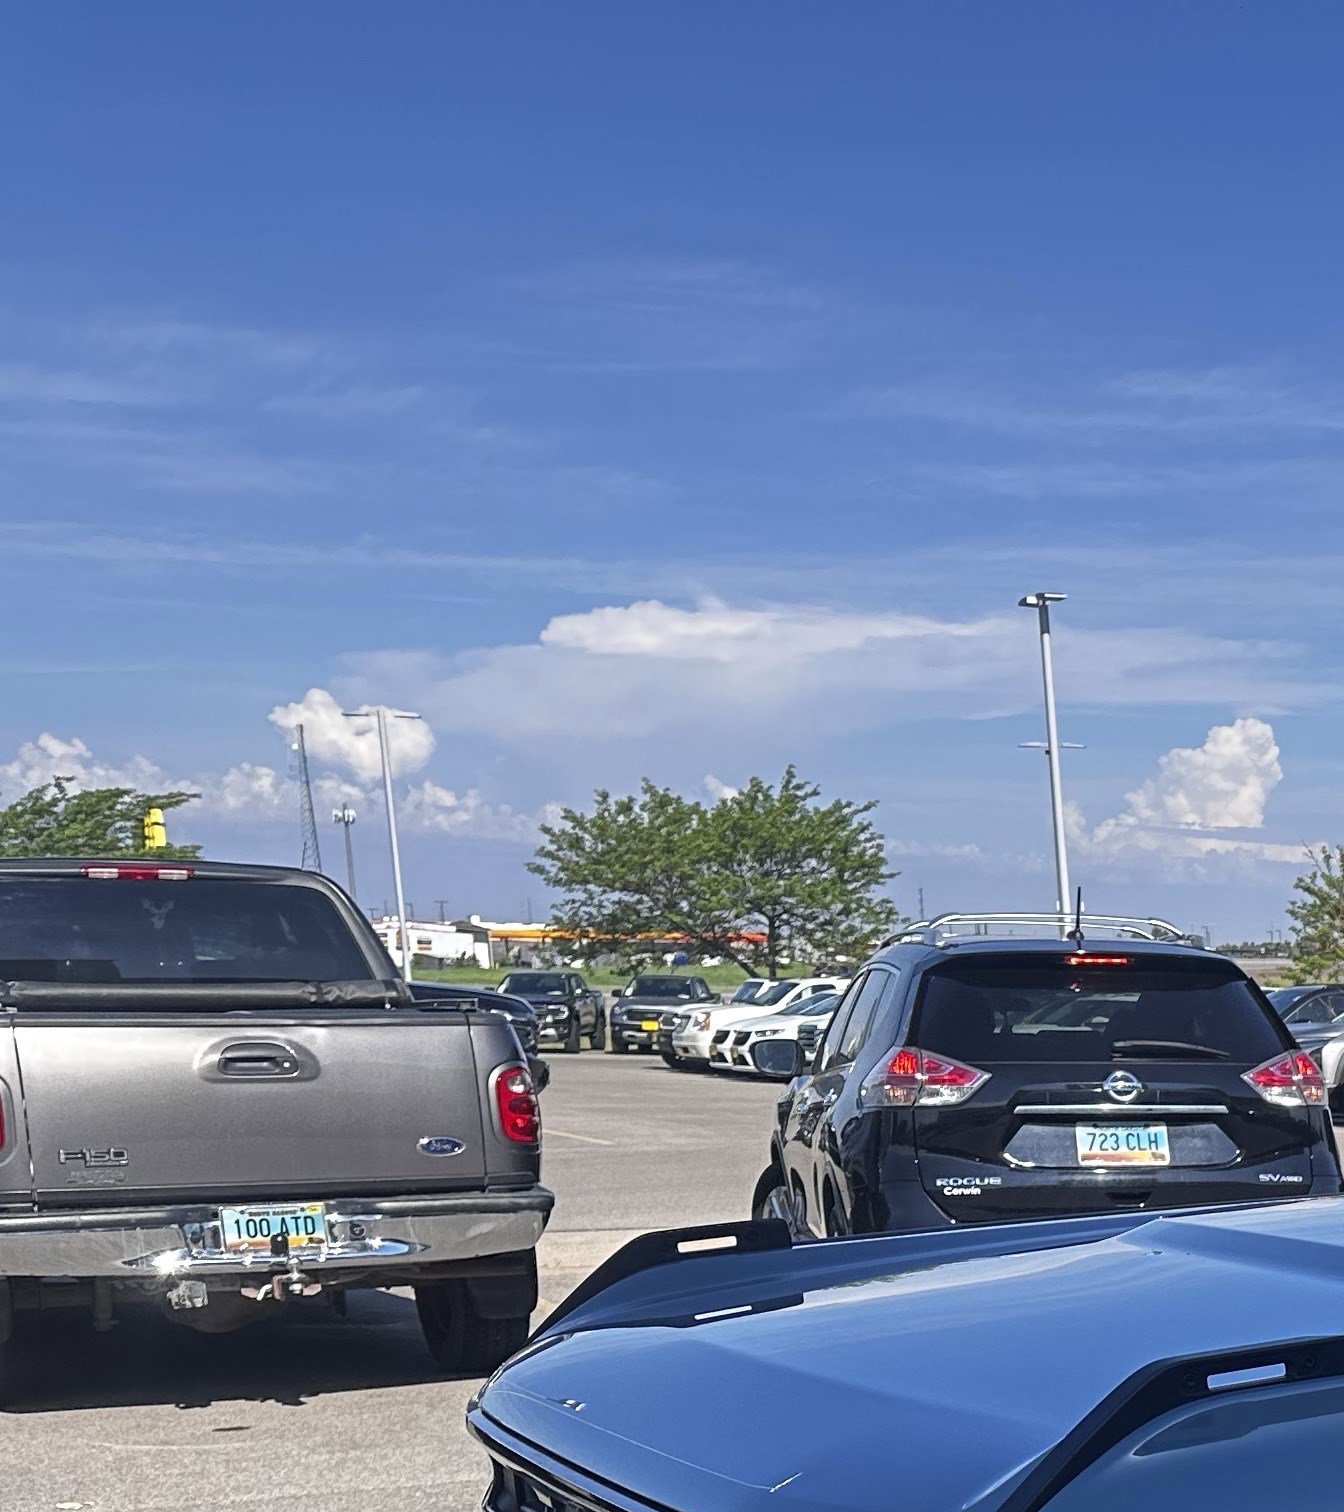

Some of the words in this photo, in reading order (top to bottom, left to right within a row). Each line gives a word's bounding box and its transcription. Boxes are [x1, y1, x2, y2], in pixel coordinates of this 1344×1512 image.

[1086, 1132, 1120, 1151] 723
[1126, 1132, 1159, 1151] CLH
[936, 1177, 1002, 1186] ROGUE
[1259, 1173, 1280, 1182] SV
[943, 1186, 982, 1196] Corwin
[235, 1218, 271, 1239] 100
[280, 1215, 316, 1236] ATD
